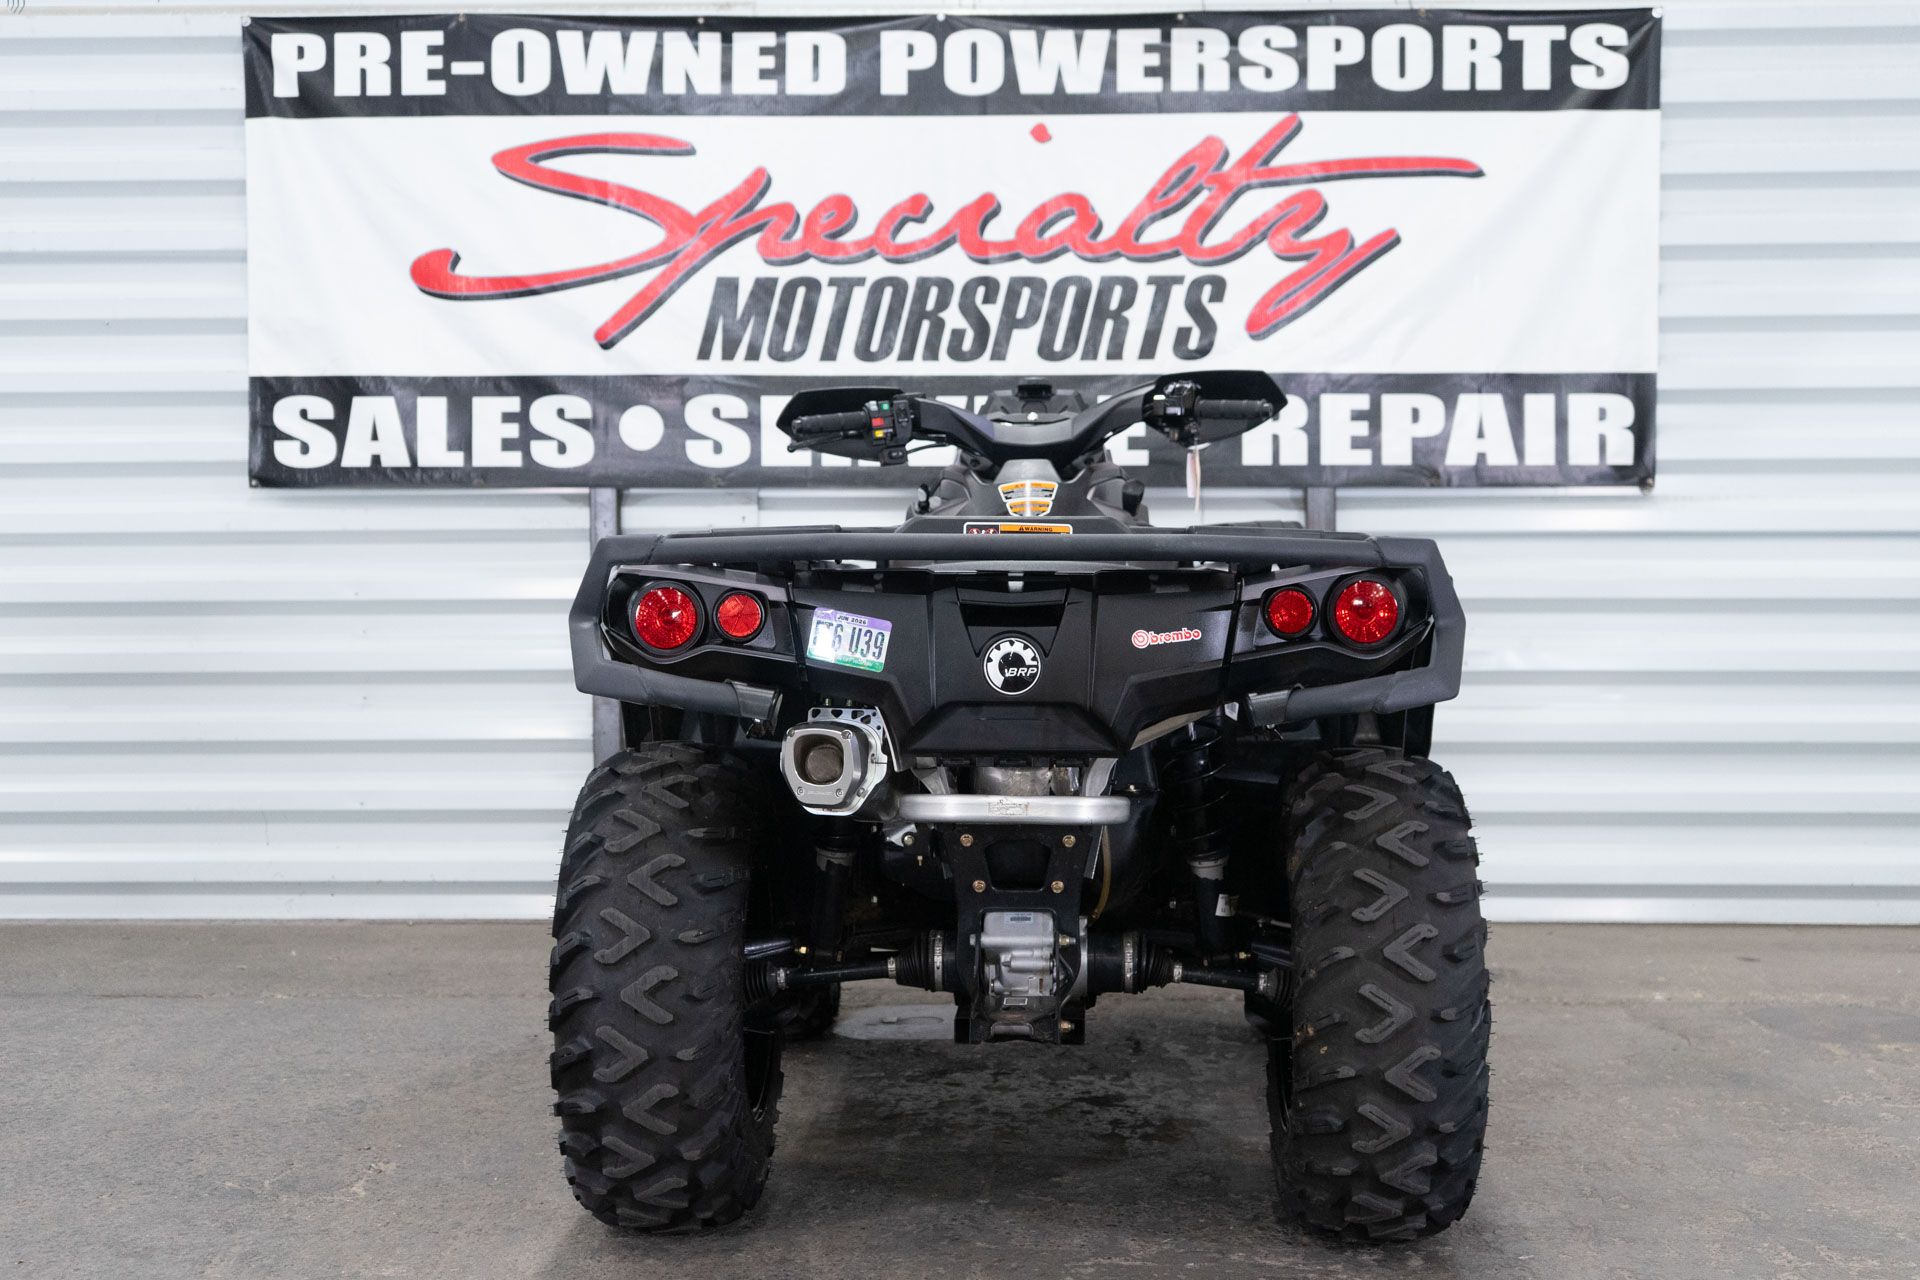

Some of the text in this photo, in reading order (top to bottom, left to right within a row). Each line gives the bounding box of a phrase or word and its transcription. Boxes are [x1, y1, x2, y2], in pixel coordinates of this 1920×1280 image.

[270, 23, 1631, 98] PRE-OWNED POWERSPORTS
[409, 112, 1485, 350] Specialty
[697, 274, 1227, 363] MOTORSPORTS
[271, 394, 595, 469] SALES
[1240, 391, 1637, 468] REPAIR
[1007, 667, 1037, 678] BRP
[1150, 628, 1201, 645] brembo
